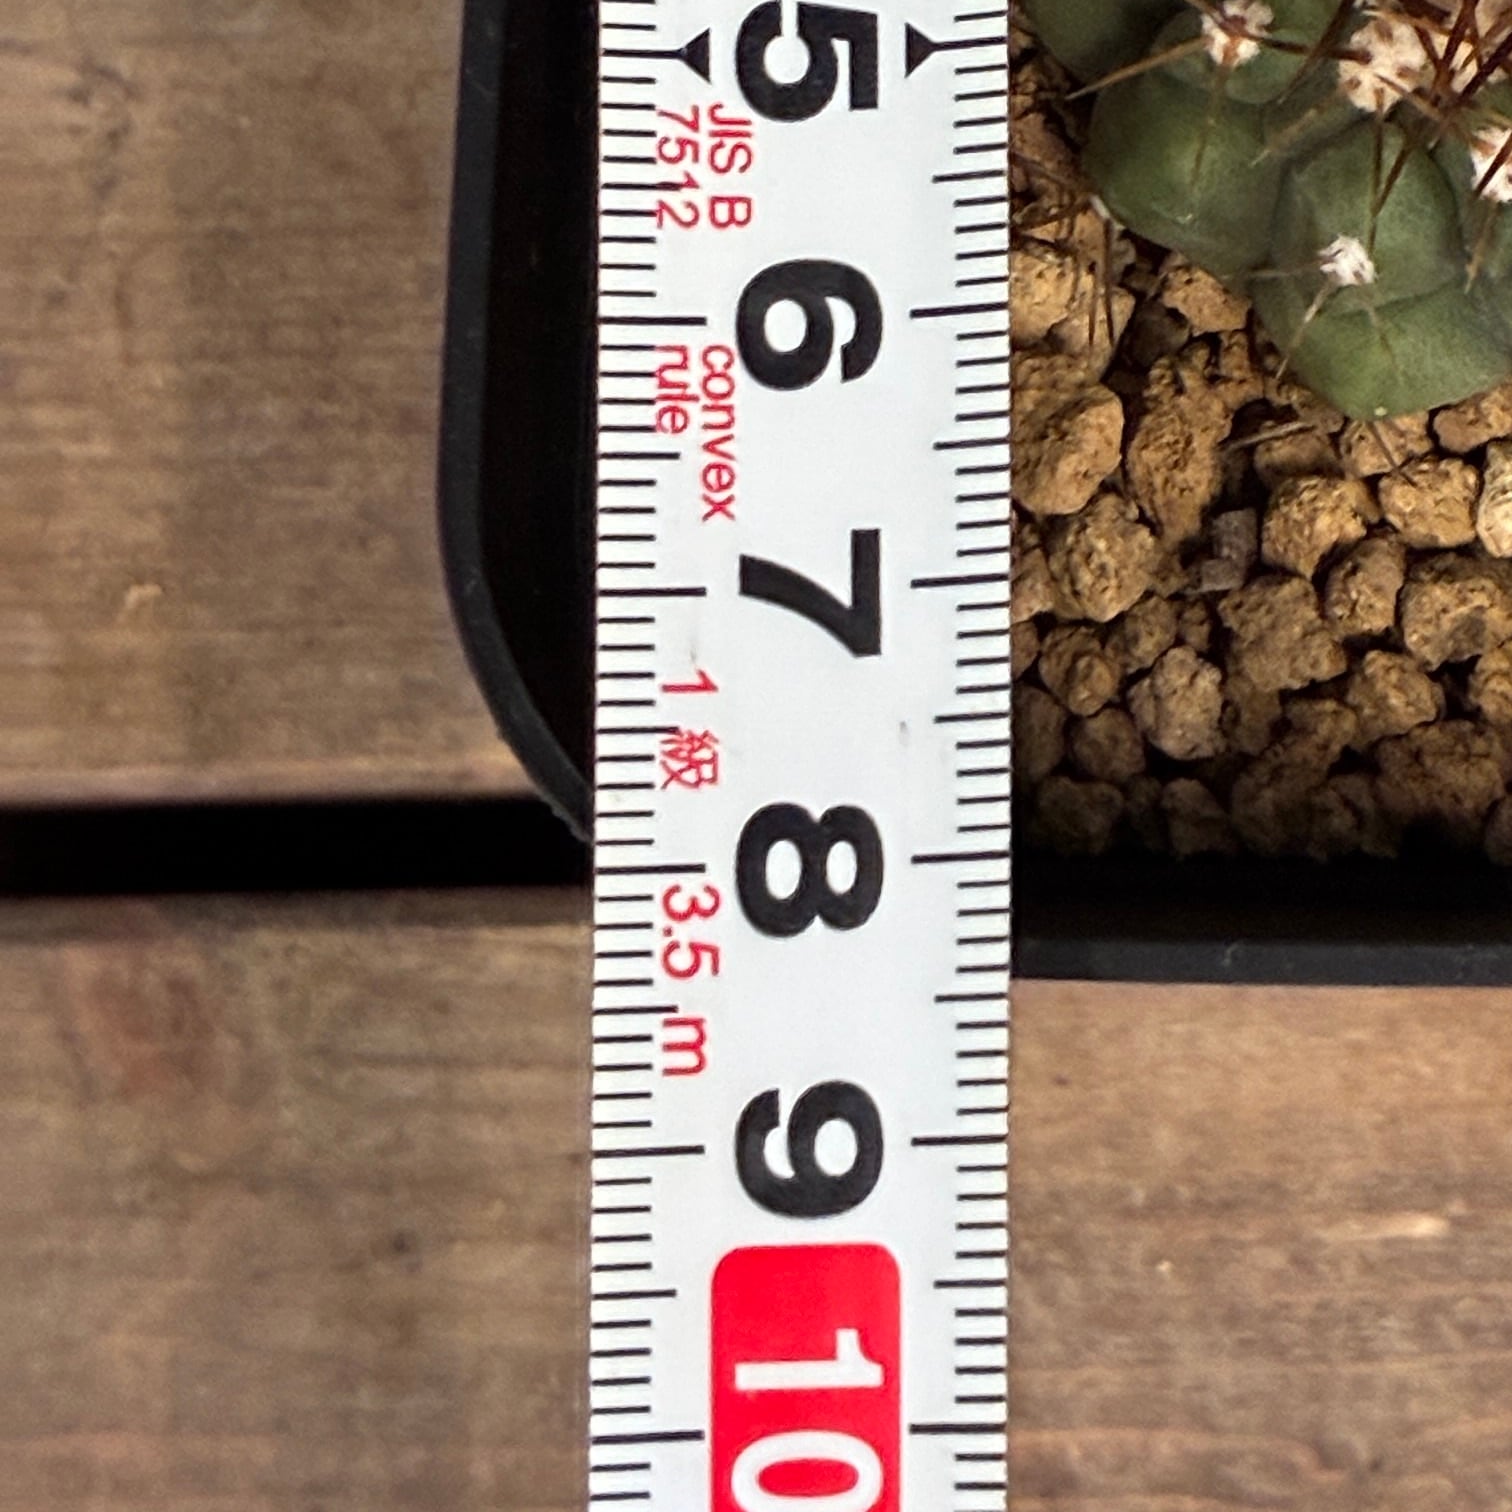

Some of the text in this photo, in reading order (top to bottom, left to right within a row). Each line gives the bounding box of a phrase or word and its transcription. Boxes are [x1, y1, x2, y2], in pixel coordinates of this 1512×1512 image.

[655, 103, 701, 230] 7512
[706, 101, 753, 231] JIS B
[655, 344, 700, 435] rule
[735, 258, 884, 392] 6
[700, 344, 737, 522] convex
[738, 528, 882, 658] 7
[735, 802, 884, 938] 8
[734, 1079, 884, 1220] 9
[730, 1327, 885, 1512] 10
